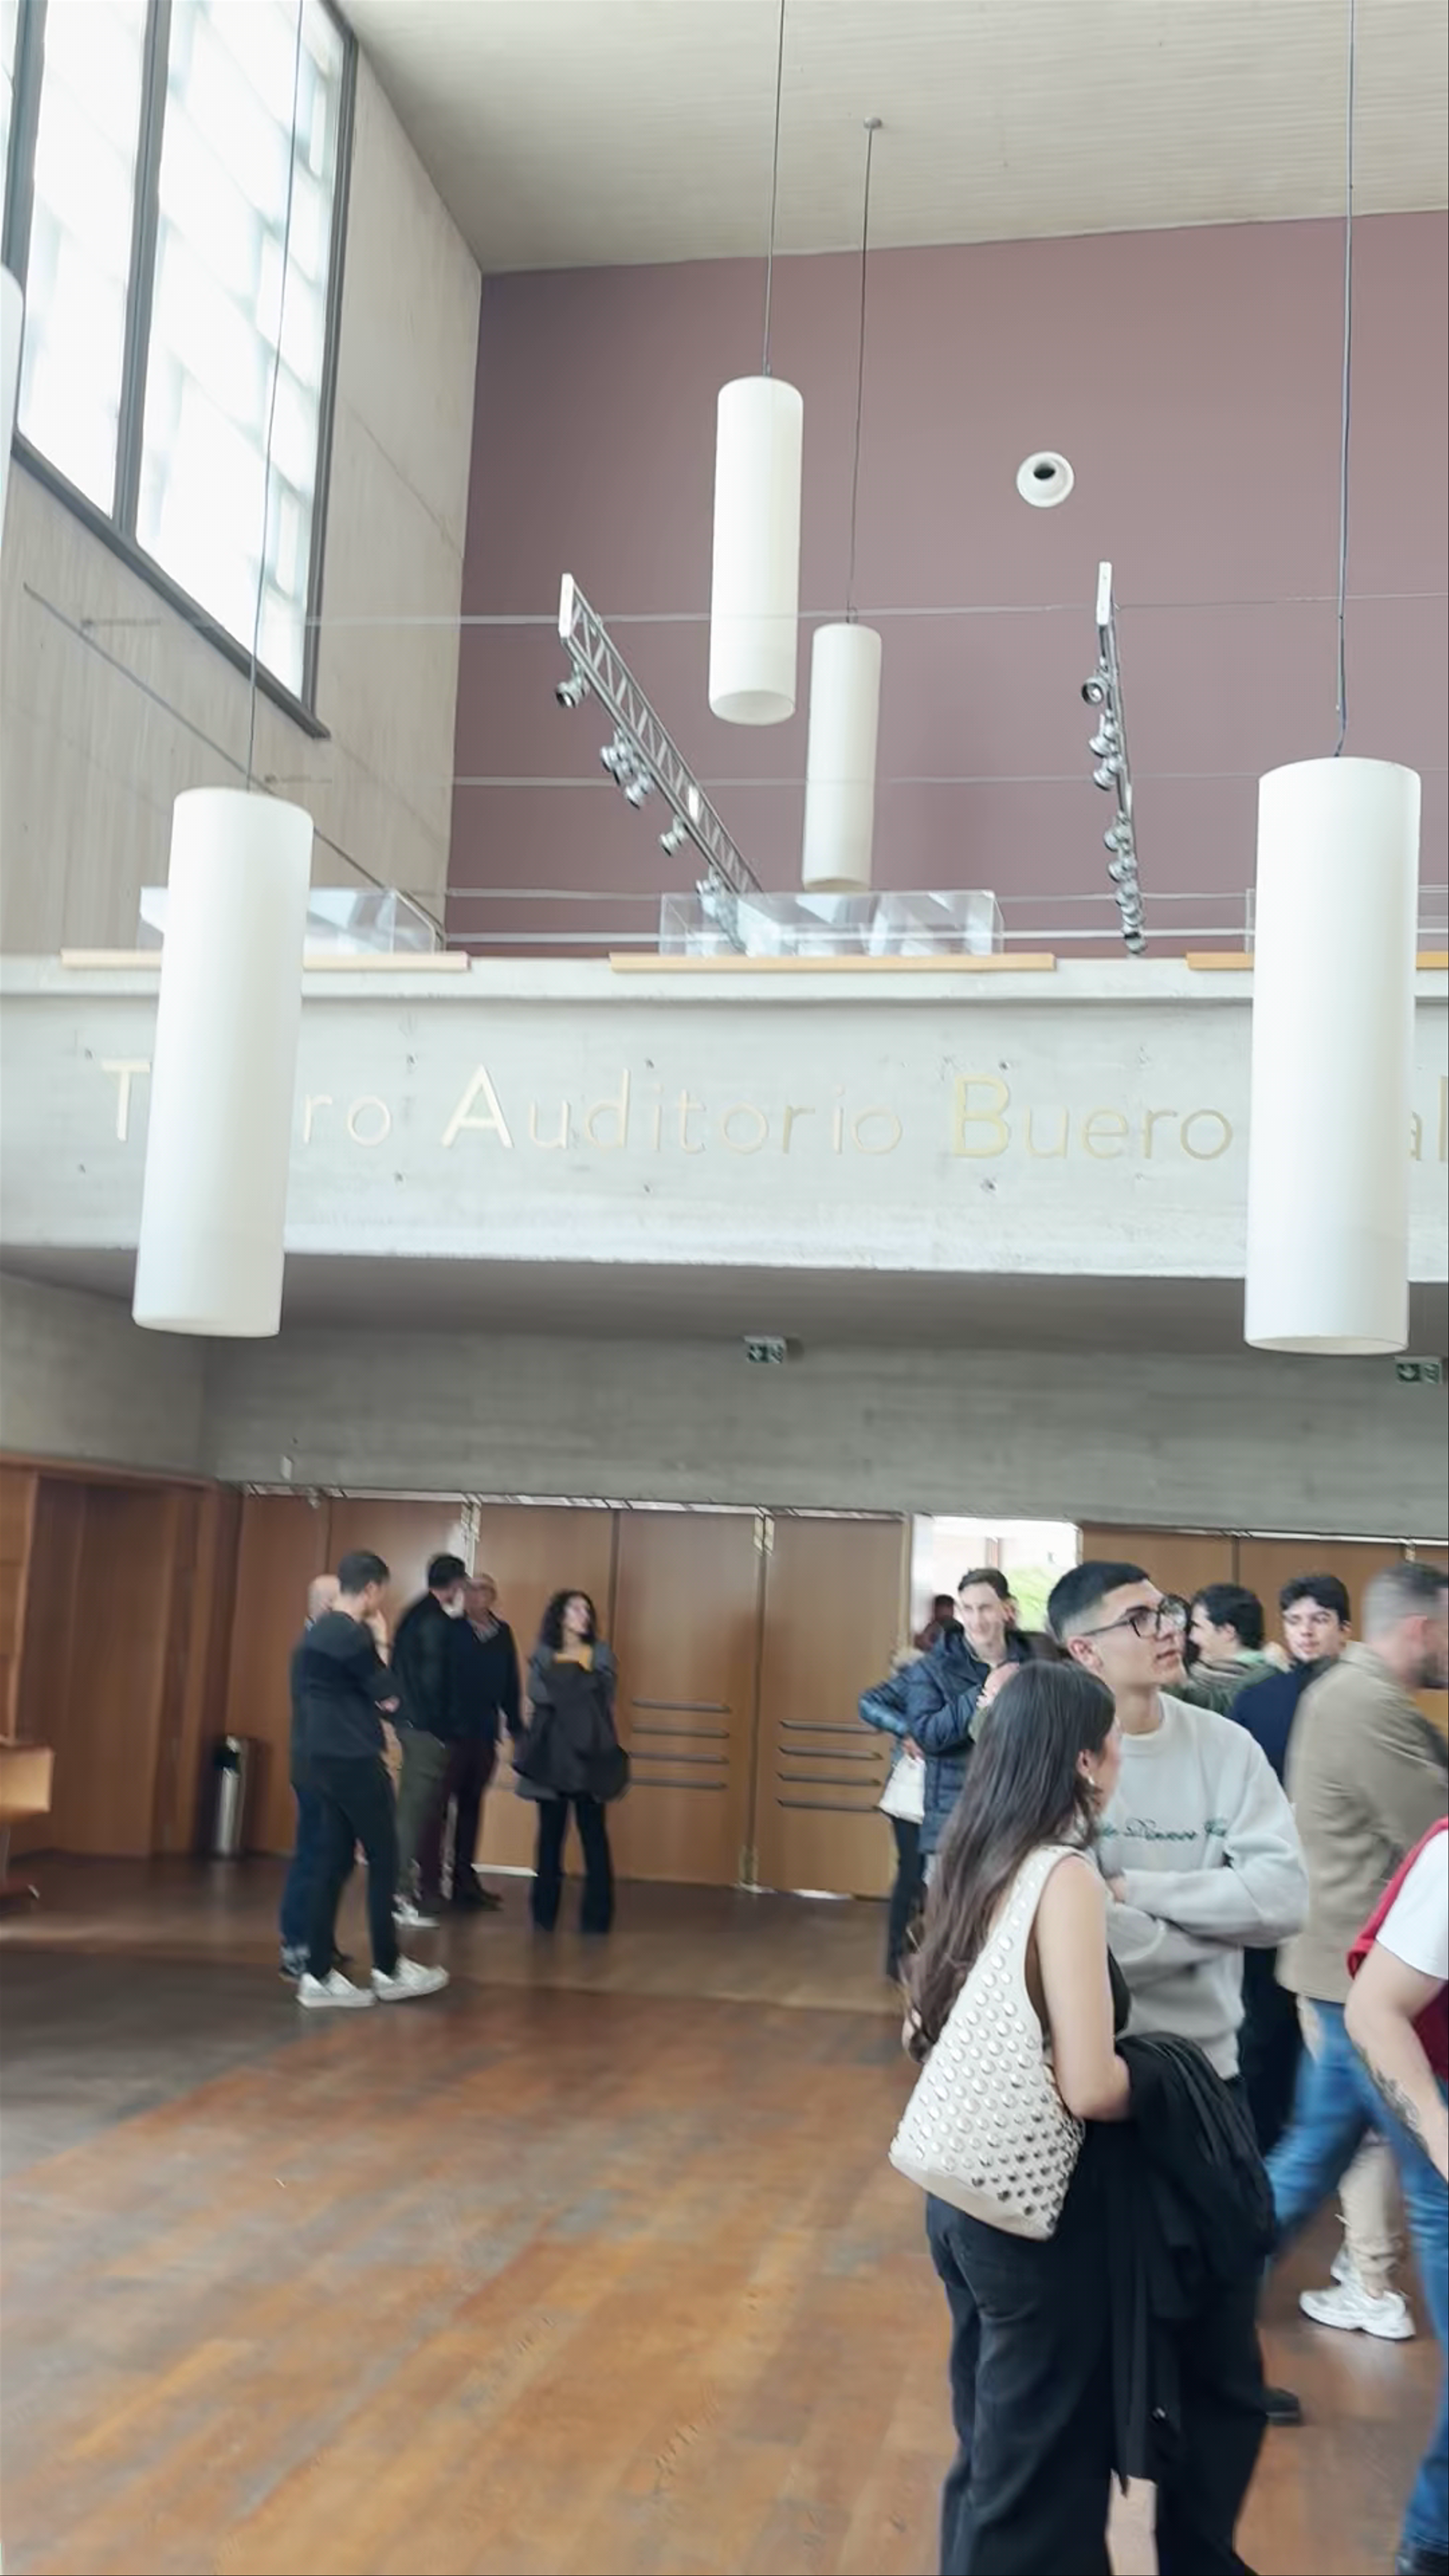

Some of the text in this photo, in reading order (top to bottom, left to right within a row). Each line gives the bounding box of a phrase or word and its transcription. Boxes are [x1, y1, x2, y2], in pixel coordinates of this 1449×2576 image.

[101, 1060, 1233, 1160] Tro Auditorio Buero
